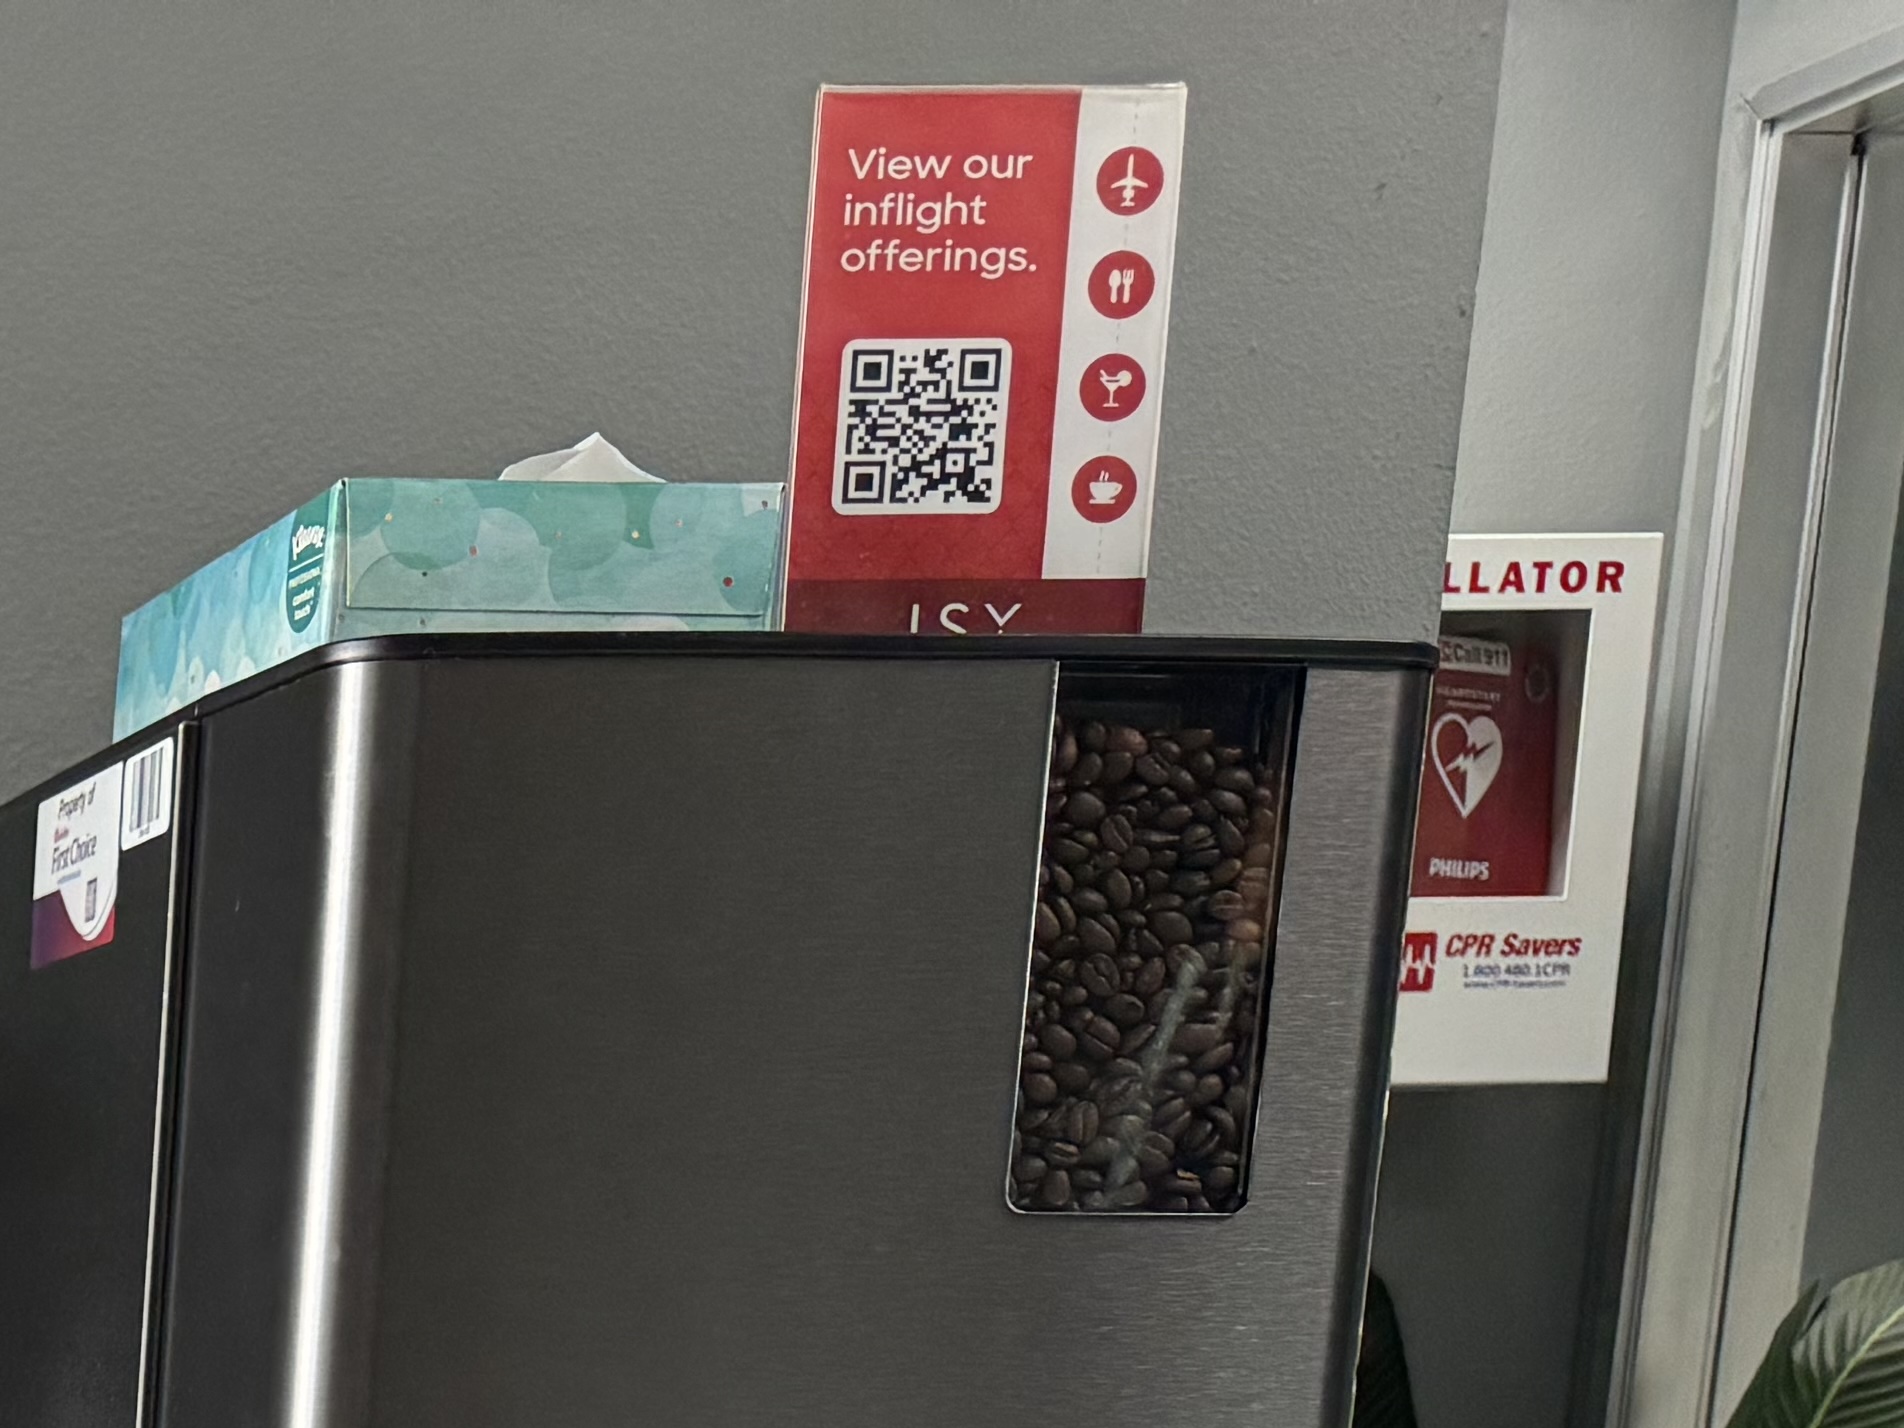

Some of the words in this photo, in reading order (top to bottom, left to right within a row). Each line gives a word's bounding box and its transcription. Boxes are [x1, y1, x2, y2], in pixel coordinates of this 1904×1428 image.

[848, 147, 952, 181] View
[963, 150, 1034, 181] our
[844, 192, 987, 235] inflight
[840, 239, 1038, 280] offerings.
[1429, 857, 1490, 881] PHILIPS
[1444, 933, 1496, 957] CPR
[1499, 933, 1583, 958] Savers
